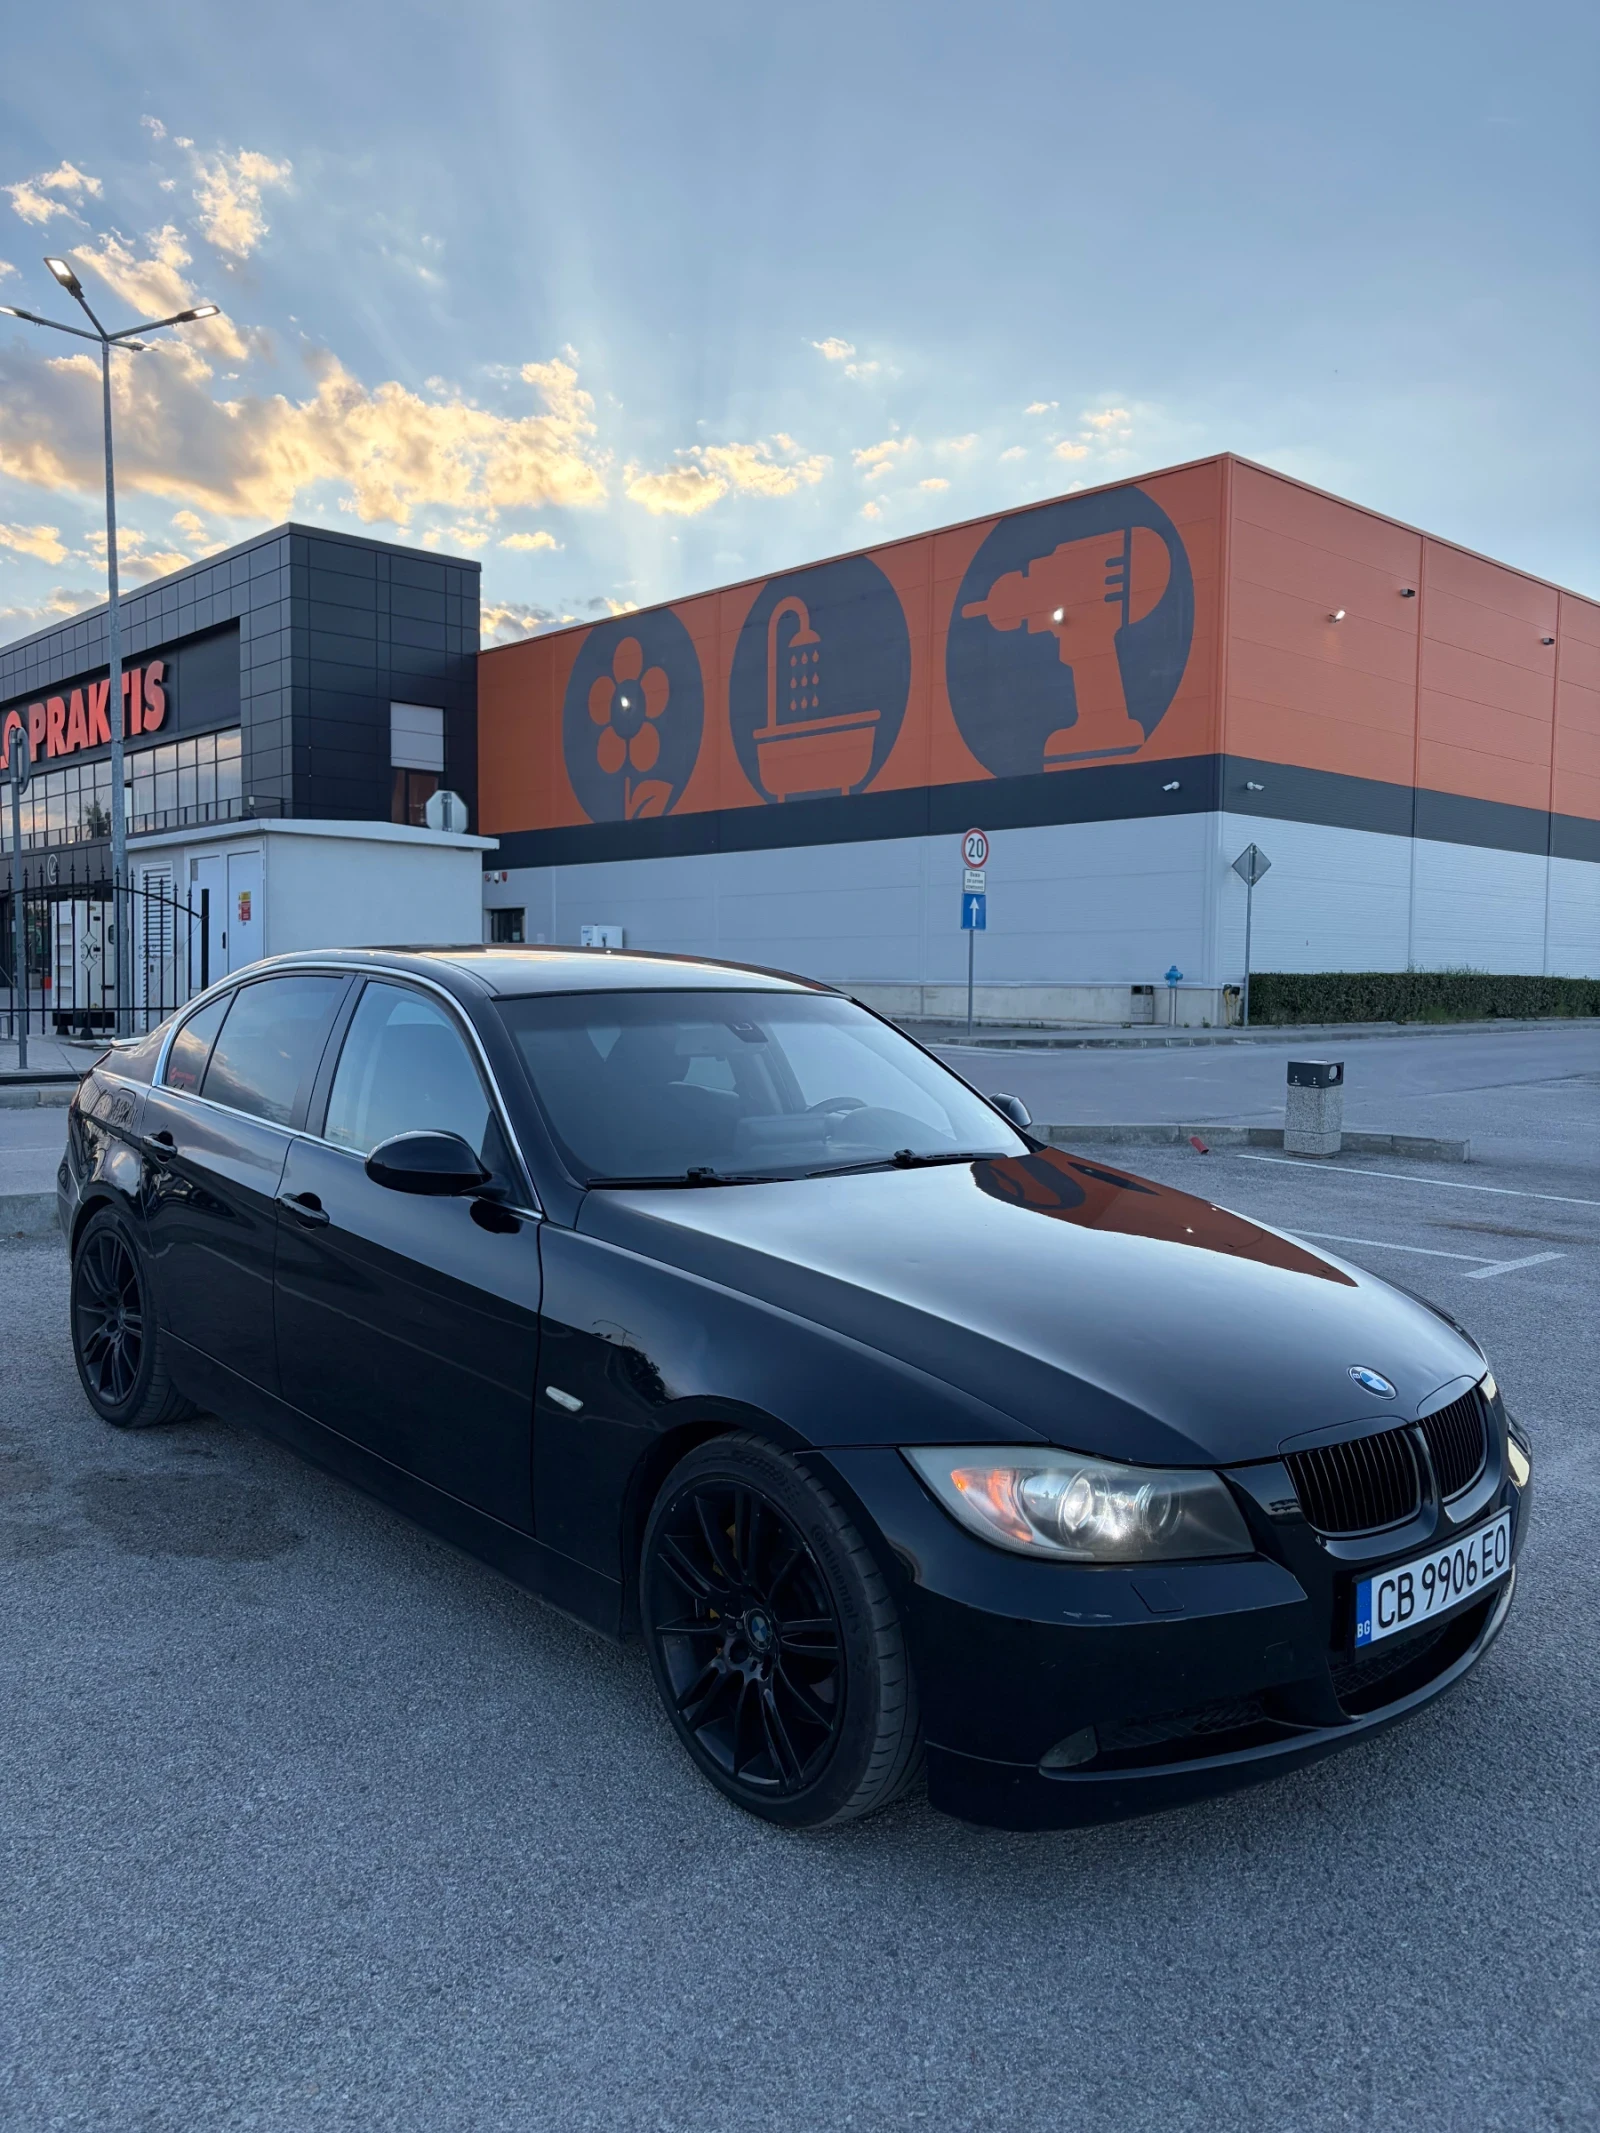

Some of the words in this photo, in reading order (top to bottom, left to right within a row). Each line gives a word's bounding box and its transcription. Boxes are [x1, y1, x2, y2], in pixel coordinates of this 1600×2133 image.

[968, 838, 984, 858] 20
[813, 1525, 858, 1617] Continental
[1378, 1572, 1415, 1629] CB
[1422, 1540, 1478, 1611] 9906
[1482, 1524, 1506, 1579] EO
[1357, 1620, 1371, 1638] BG
